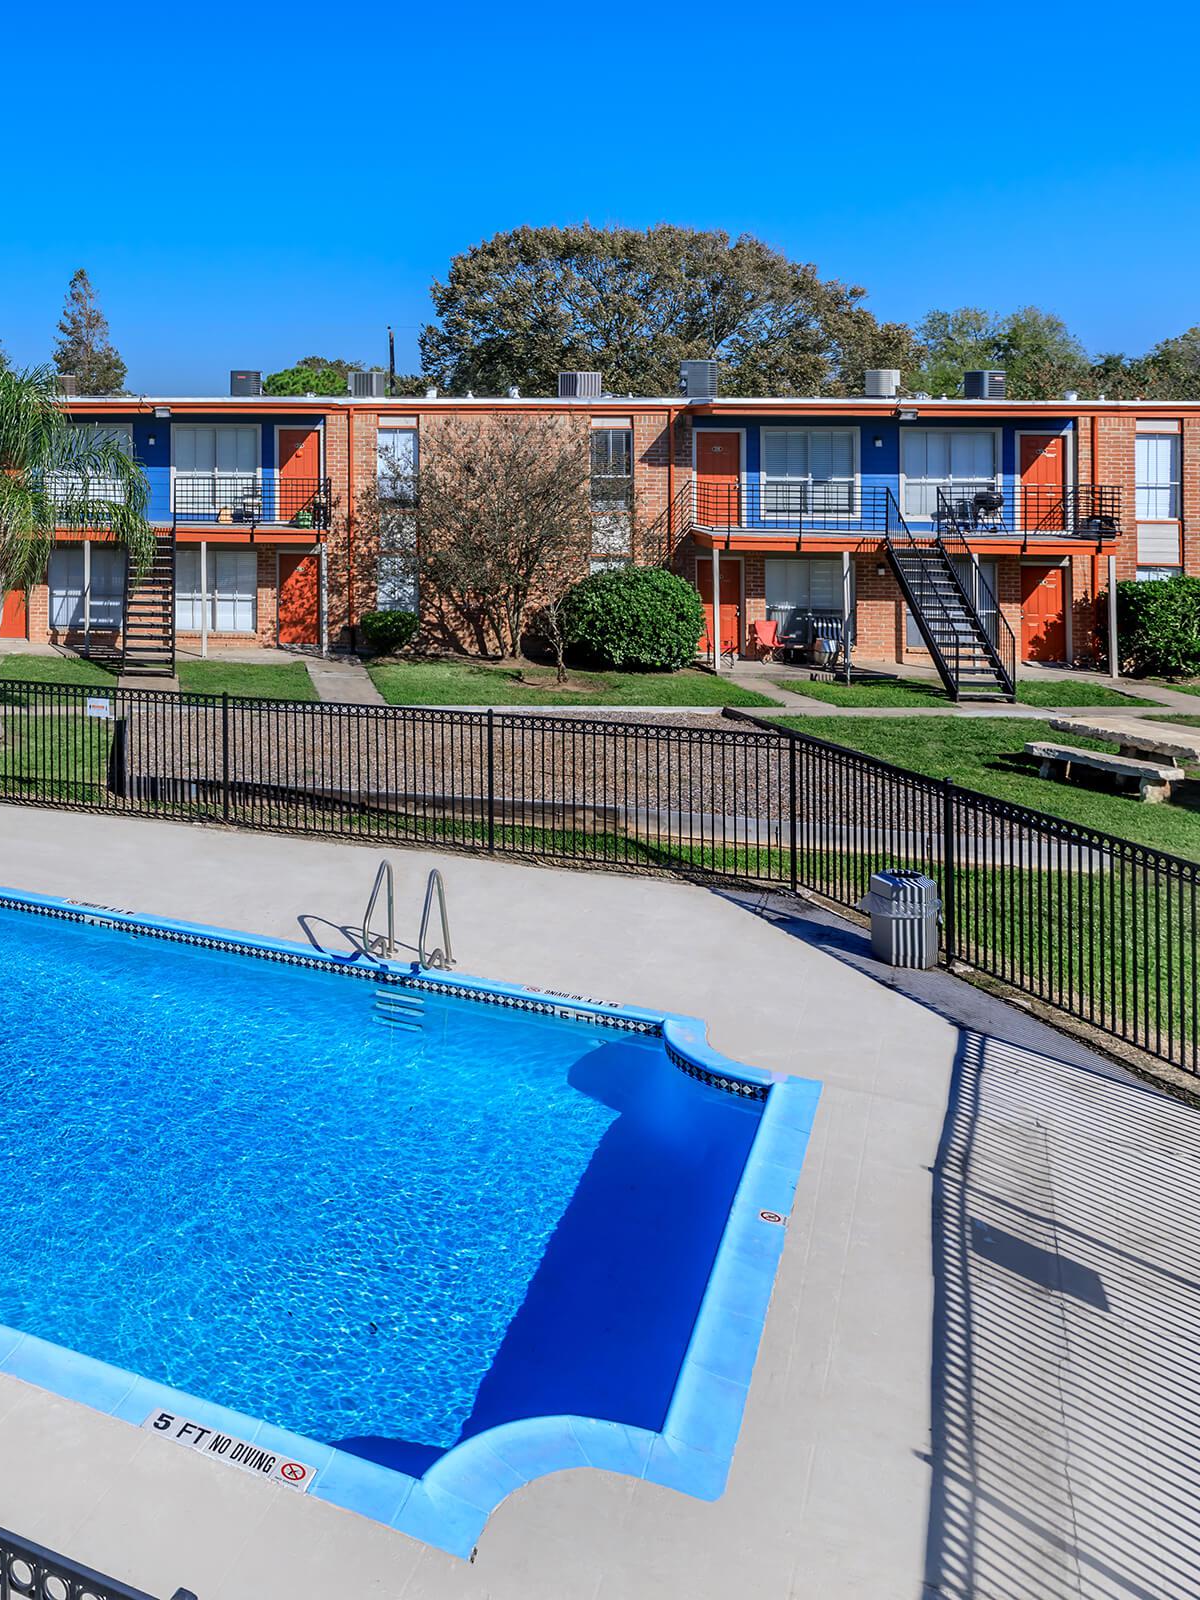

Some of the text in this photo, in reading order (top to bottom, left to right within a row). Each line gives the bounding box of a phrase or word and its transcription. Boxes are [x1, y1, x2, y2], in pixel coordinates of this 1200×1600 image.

[544, 989, 570, 998] DIVING
[152, 1412, 277, 1474] 5 FT NO DIVING
